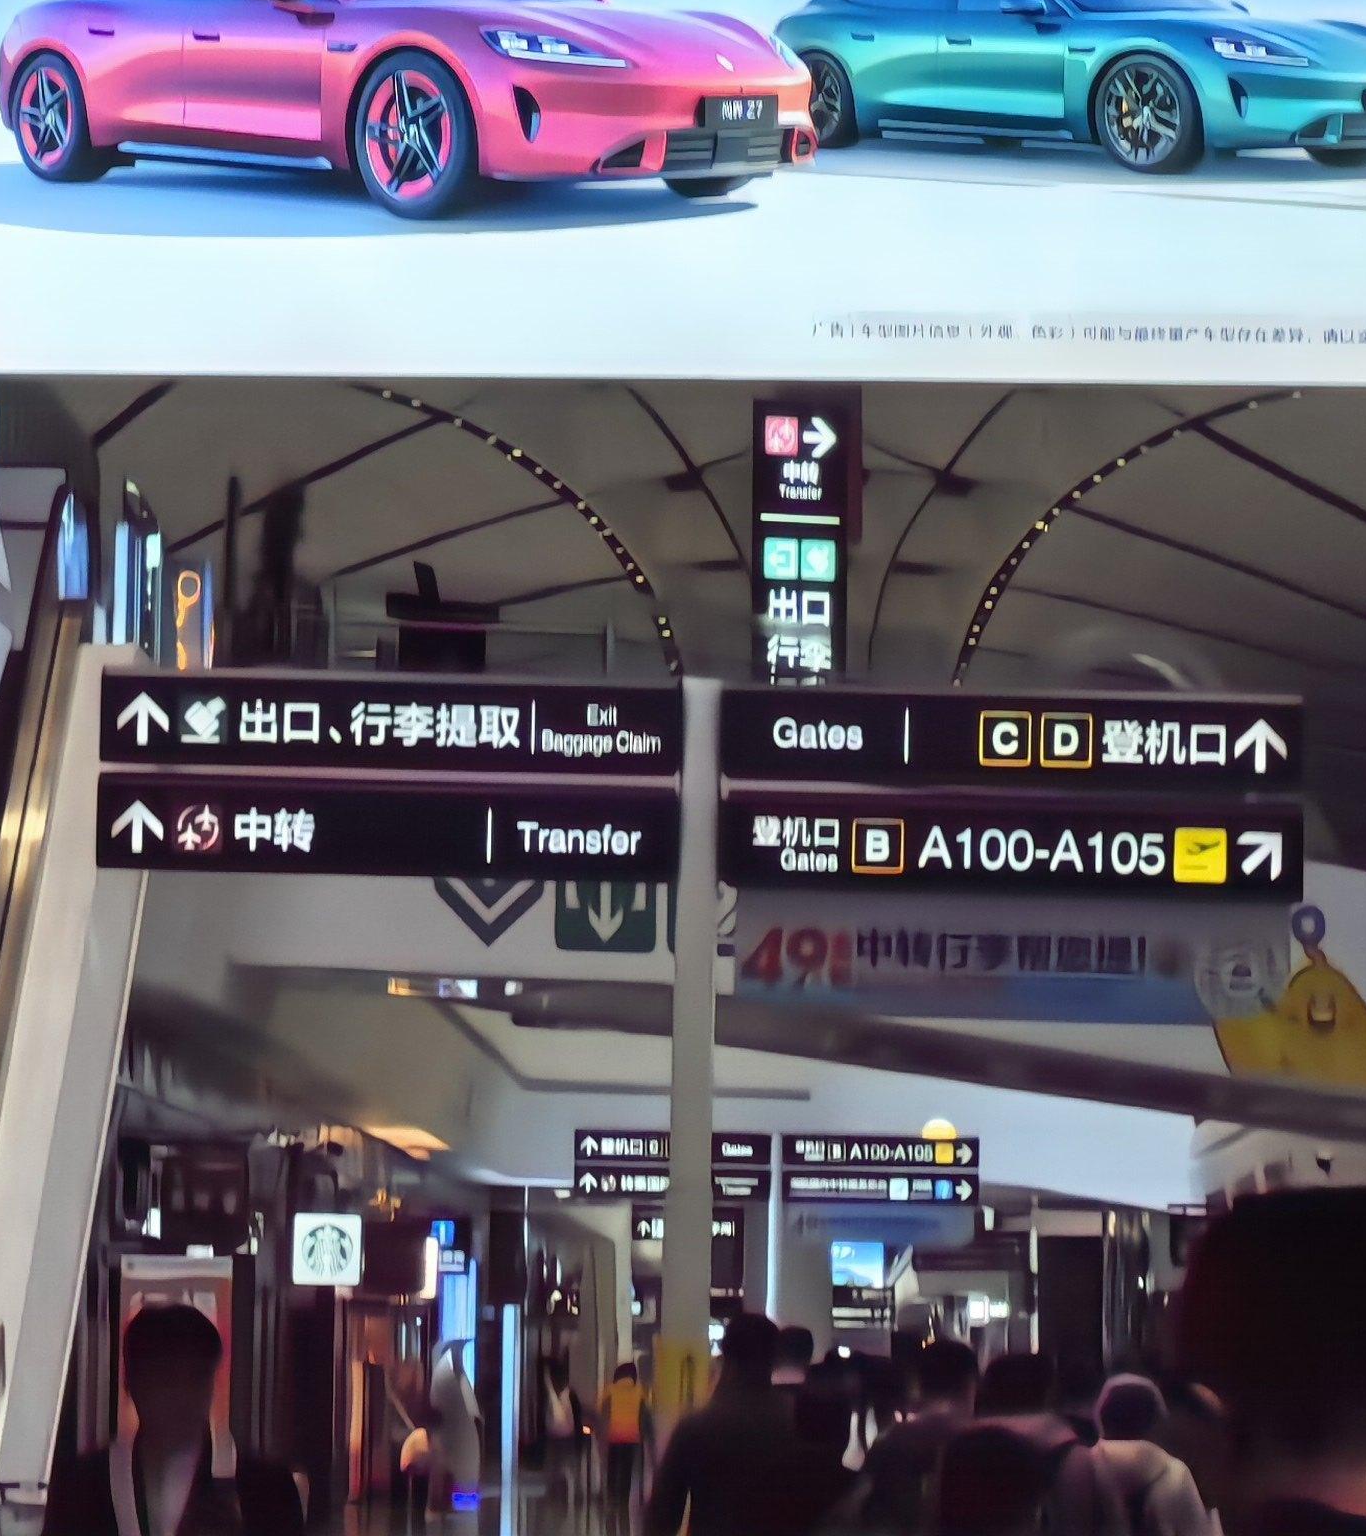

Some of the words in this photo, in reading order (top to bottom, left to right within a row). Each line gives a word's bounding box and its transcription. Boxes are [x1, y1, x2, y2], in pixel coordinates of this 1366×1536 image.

[239, 698, 520, 749] 出口、行李提取
[587, 703, 617, 727] Exit
[772, 716, 864, 752] Gates
[541, 728, 613, 758] Baggage
[616, 729, 662, 755] Claim
[991, 722, 1019, 756] C
[1053, 723, 1080, 757] D
[1101, 719, 1227, 766] 登机口
[235, 806, 315, 854] 中转
[517, 819, 642, 856] Transfer
[865, 828, 890, 863] B
[918, 825, 1166, 876] A100-A105
